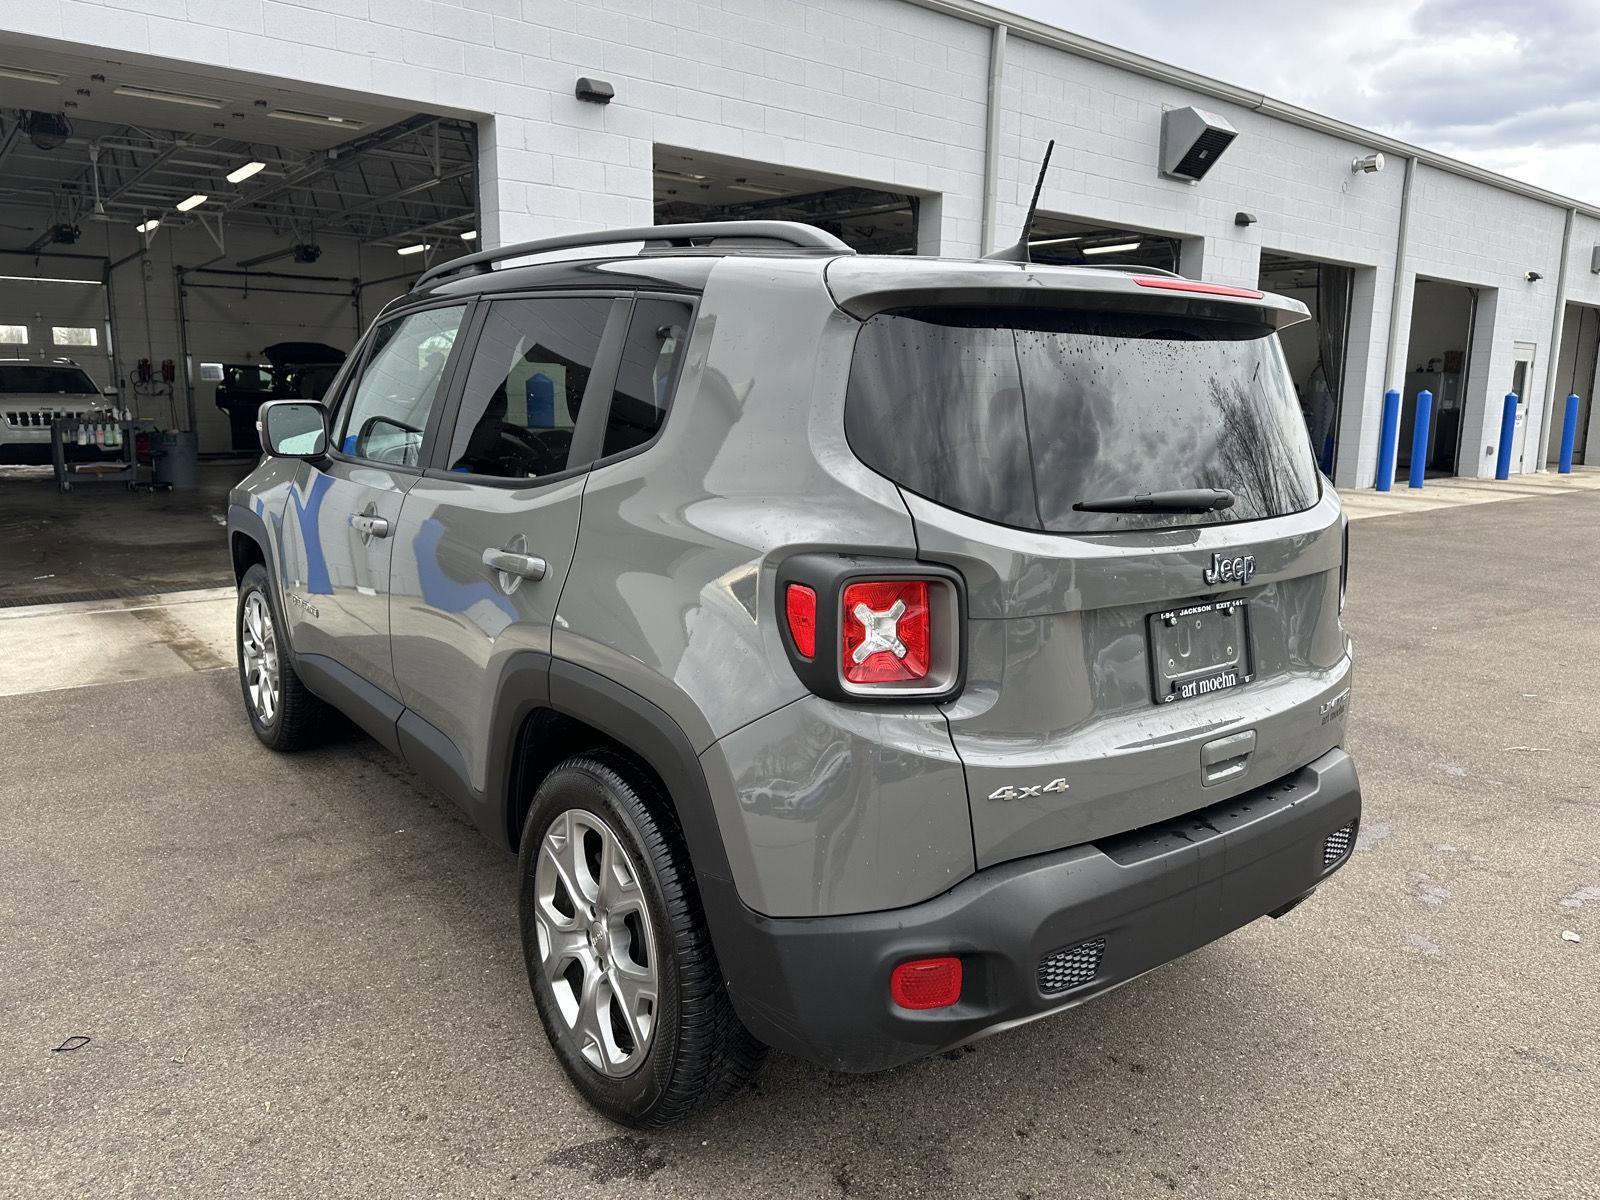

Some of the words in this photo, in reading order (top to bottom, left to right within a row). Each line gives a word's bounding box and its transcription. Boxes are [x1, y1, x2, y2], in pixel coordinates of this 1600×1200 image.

[1203, 552, 1256, 586] Jeep
[1160, 611, 1174, 620] I-94
[1179, 604, 1212, 616] JACKSON
[1215, 601, 1231, 610] EXIT
[1231, 599, 1243, 607] 141
[1181, 679, 1198, 698] art
[1199, 672, 1236, 693] moehn
[987, 777, 1070, 801] 4x4
